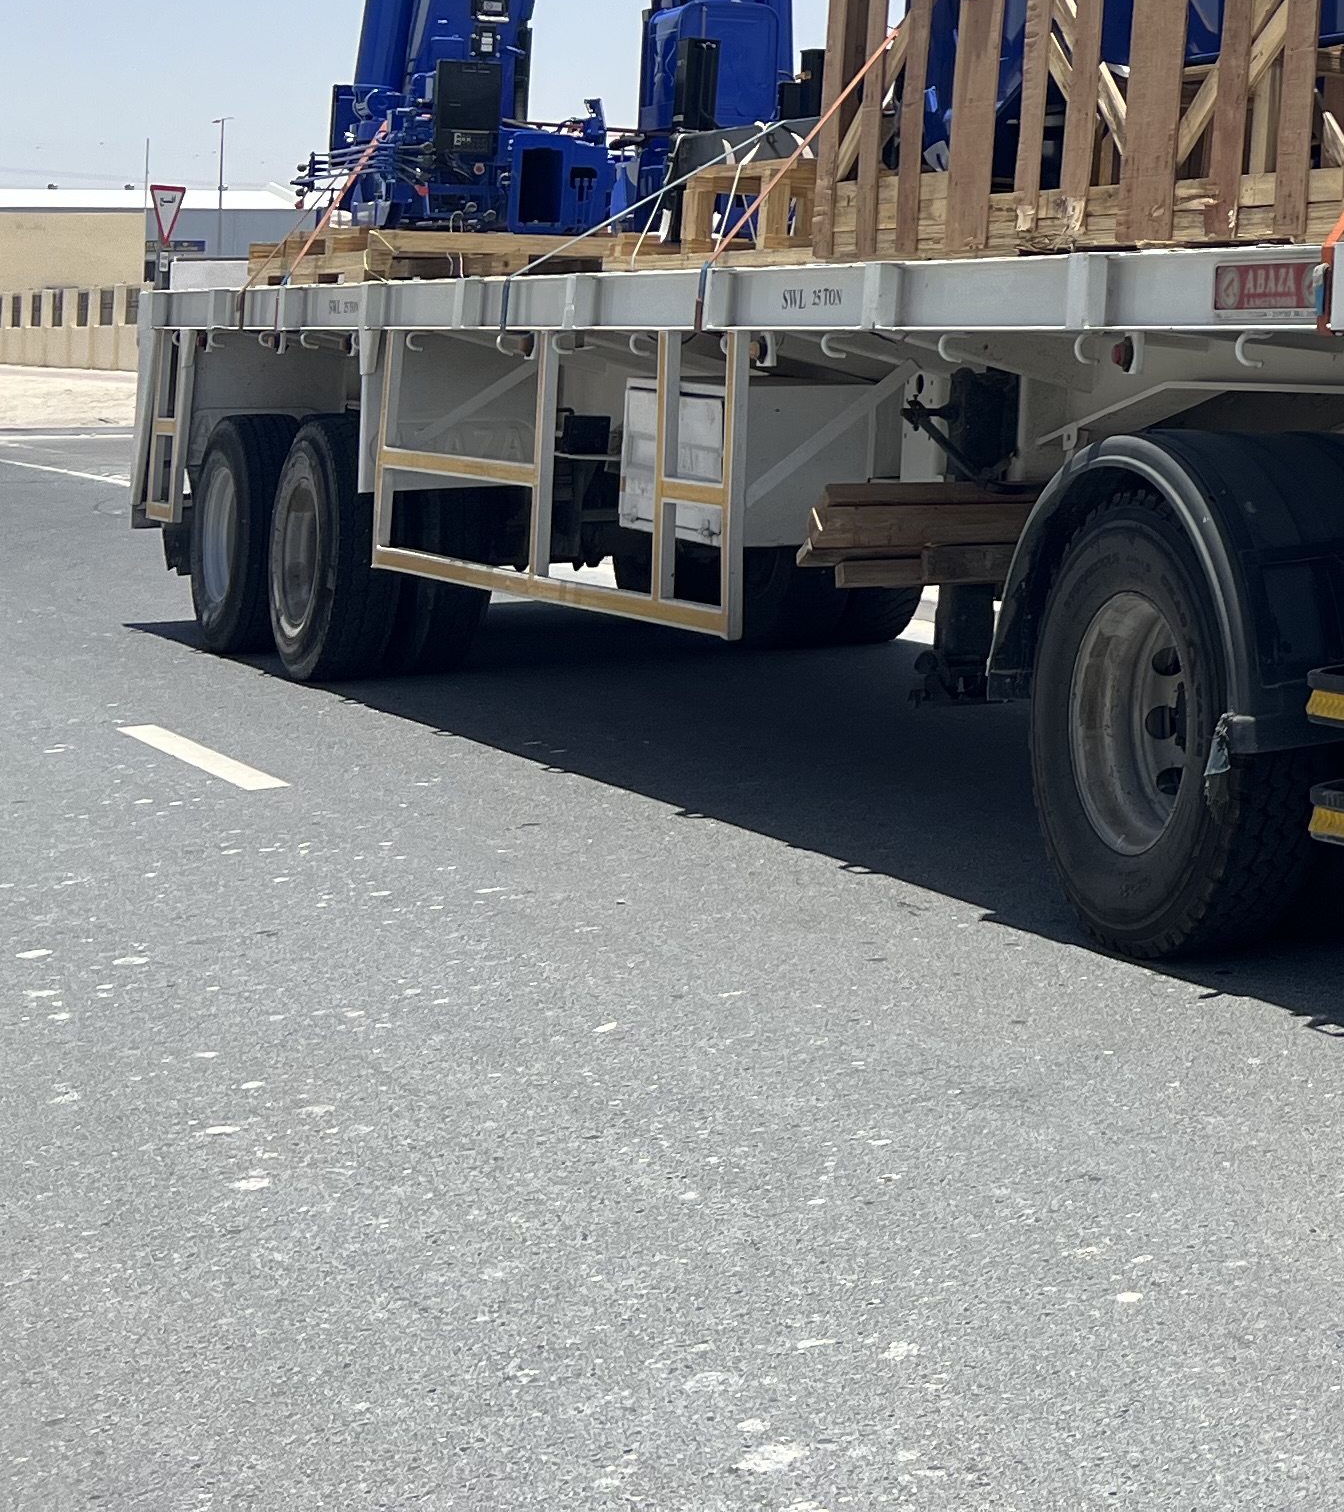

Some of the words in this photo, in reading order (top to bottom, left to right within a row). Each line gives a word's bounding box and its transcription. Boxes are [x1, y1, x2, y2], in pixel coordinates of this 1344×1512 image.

[1244, 266, 1297, 294] ABAZA
[781, 288, 806, 309] SWL
[823, 288, 843, 306] TON
